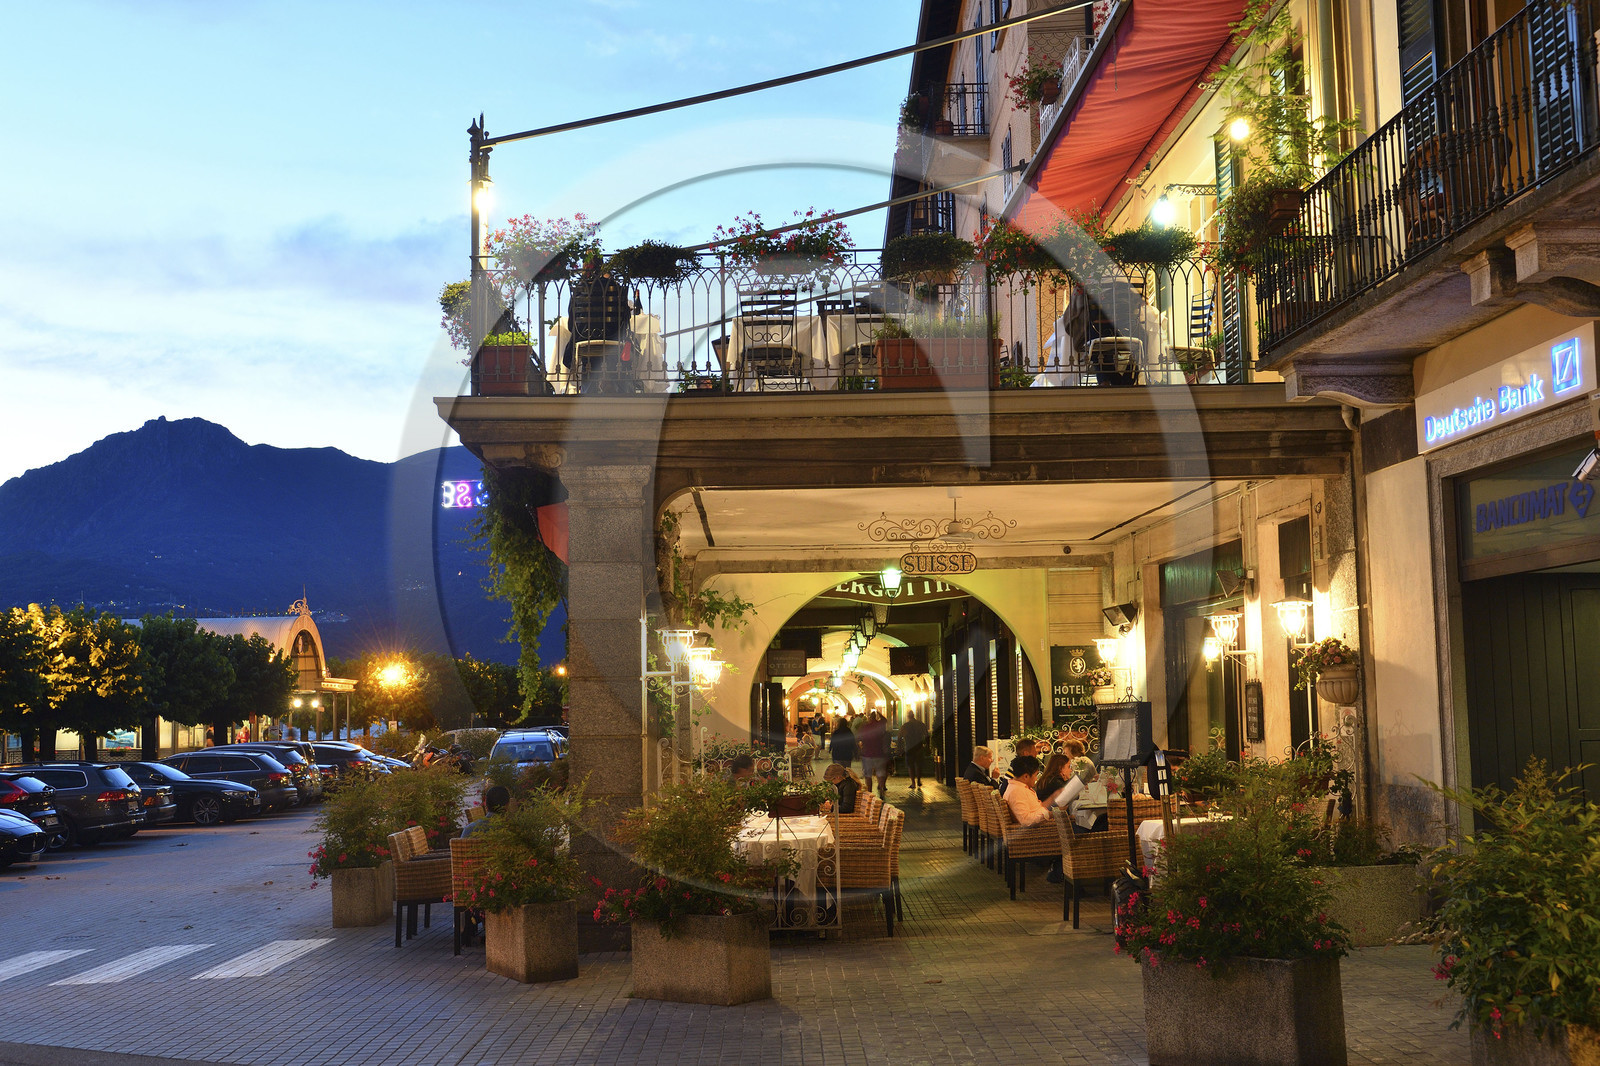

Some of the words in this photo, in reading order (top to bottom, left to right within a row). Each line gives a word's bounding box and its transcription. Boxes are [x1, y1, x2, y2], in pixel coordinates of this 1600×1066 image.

[1424, 396, 1496, 443] Deutsche
[1498, 374, 1545, 415] Bank
[1476, 482, 1569, 533] BANCOMAT
[904, 554, 973, 573] SUISSE
[1054, 685, 1085, 695] HOTEL
